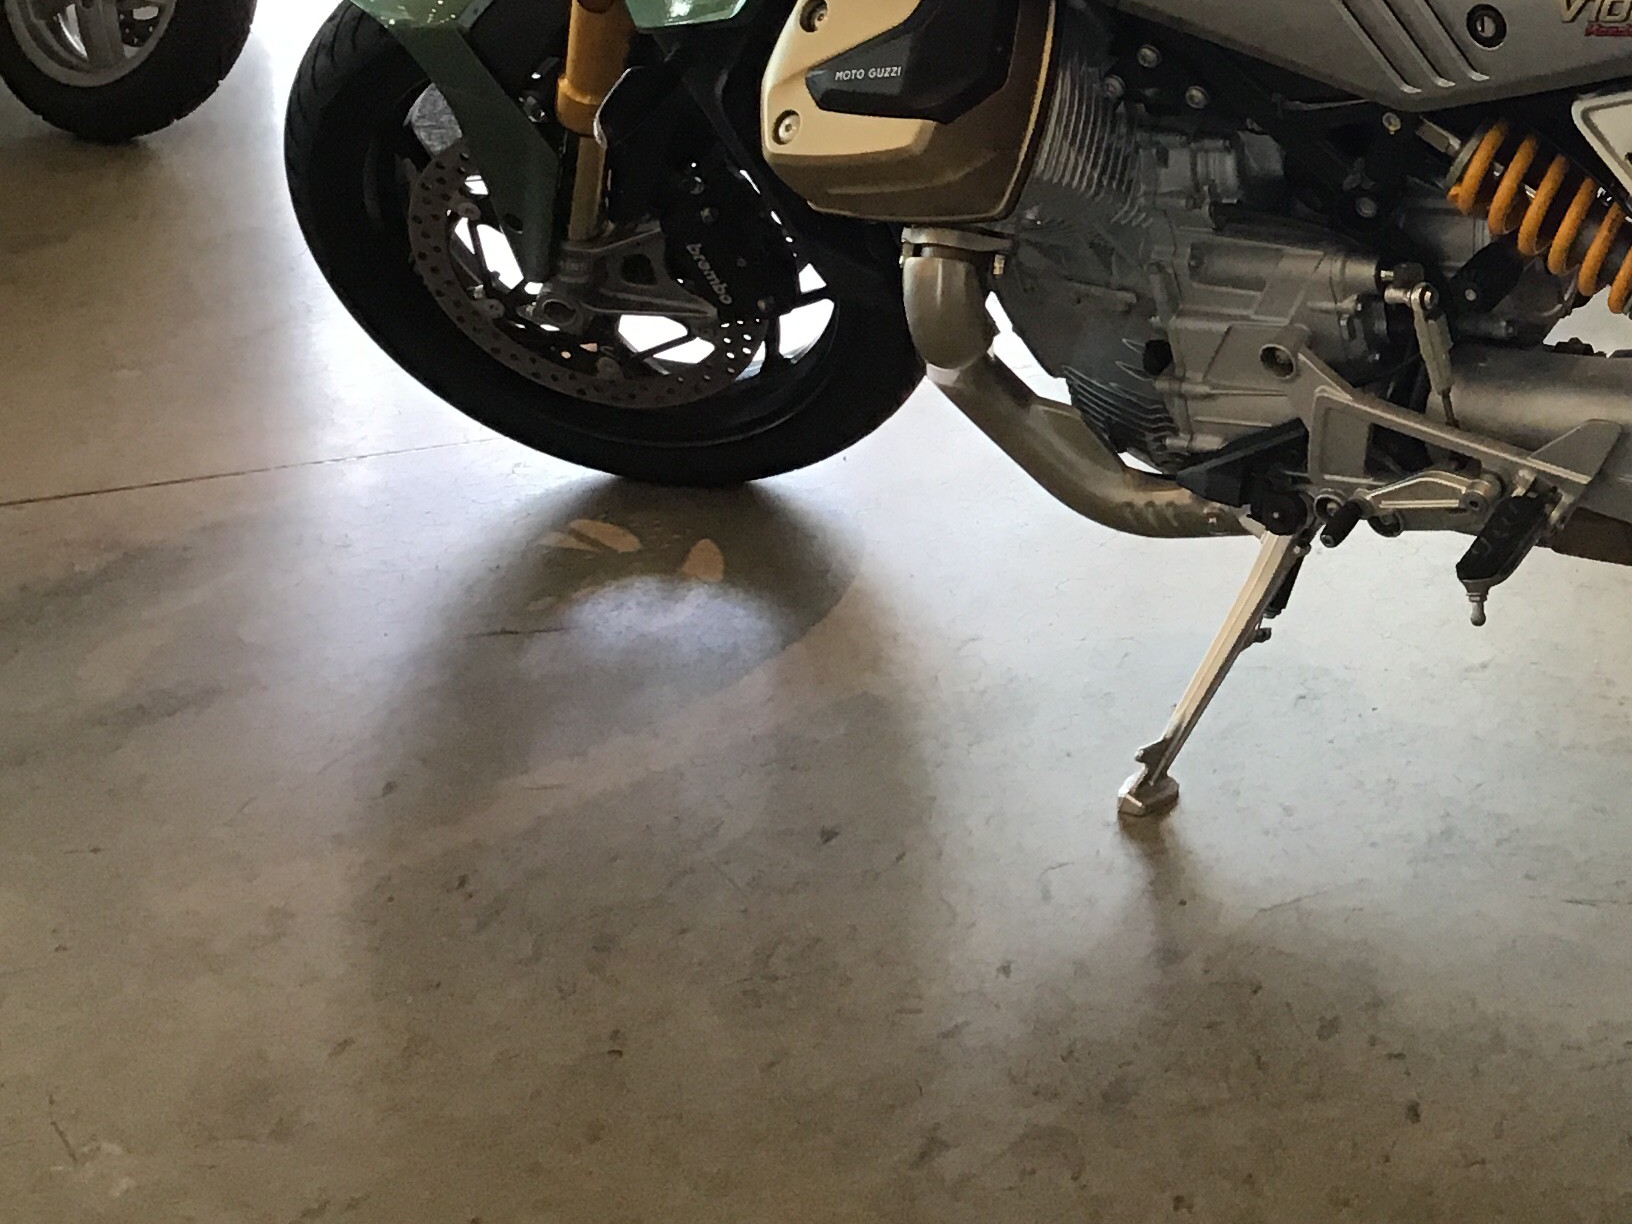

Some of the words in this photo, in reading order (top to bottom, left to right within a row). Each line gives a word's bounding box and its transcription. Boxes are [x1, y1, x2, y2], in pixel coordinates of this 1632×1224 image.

[835, 68, 865, 80] MOTO
[868, 66, 902, 78] GUZZI
[686, 243, 733, 304] brembo
